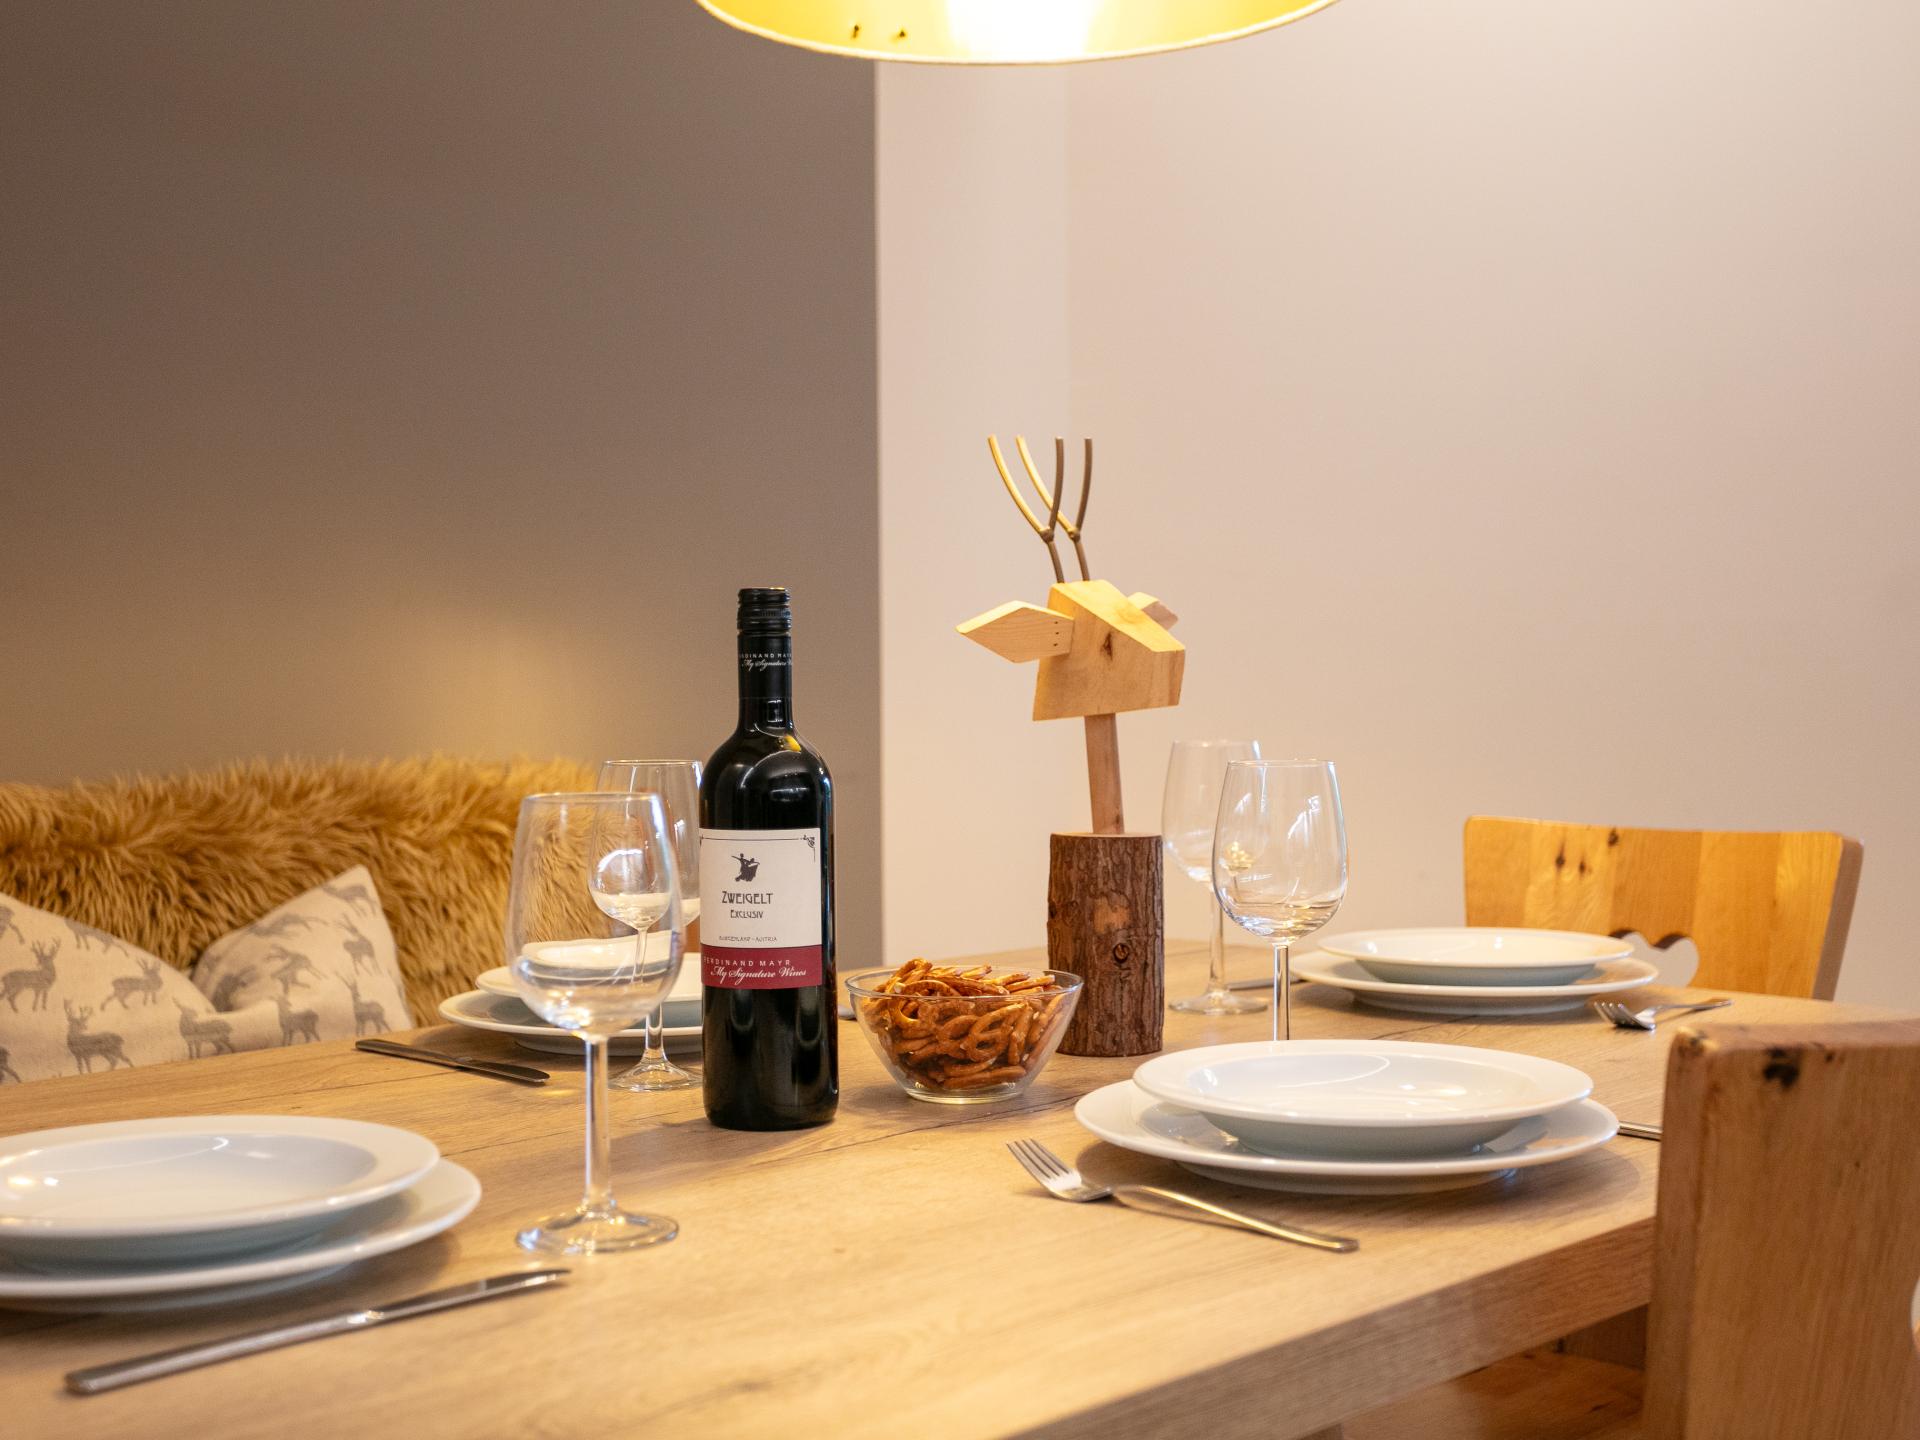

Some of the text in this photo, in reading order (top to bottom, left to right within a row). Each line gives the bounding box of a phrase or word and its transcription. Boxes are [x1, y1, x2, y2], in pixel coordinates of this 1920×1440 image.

[703, 956, 791, 967] FERDINAND MAYR
[710, 966, 807, 986] My Signature Wines
